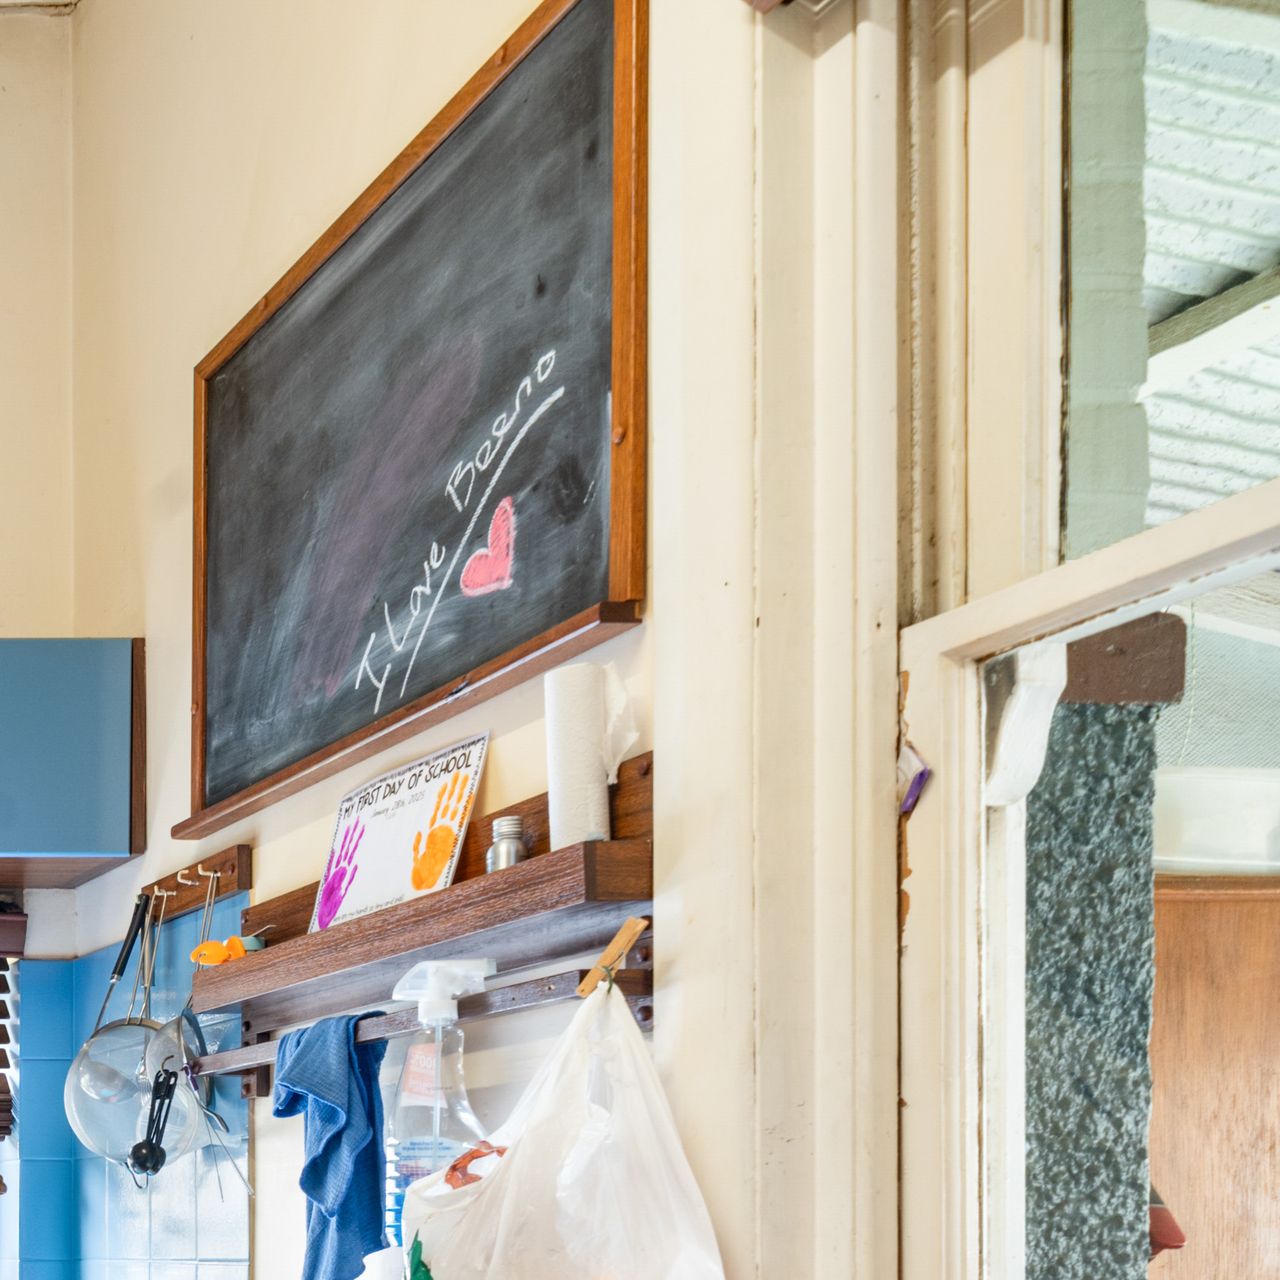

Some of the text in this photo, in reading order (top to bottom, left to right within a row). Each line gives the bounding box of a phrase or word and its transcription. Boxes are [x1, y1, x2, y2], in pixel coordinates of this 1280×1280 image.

[383, 540, 446, 652] Love
[342, 750, 472, 820] MY FIRST DAY OF SCHOOL
